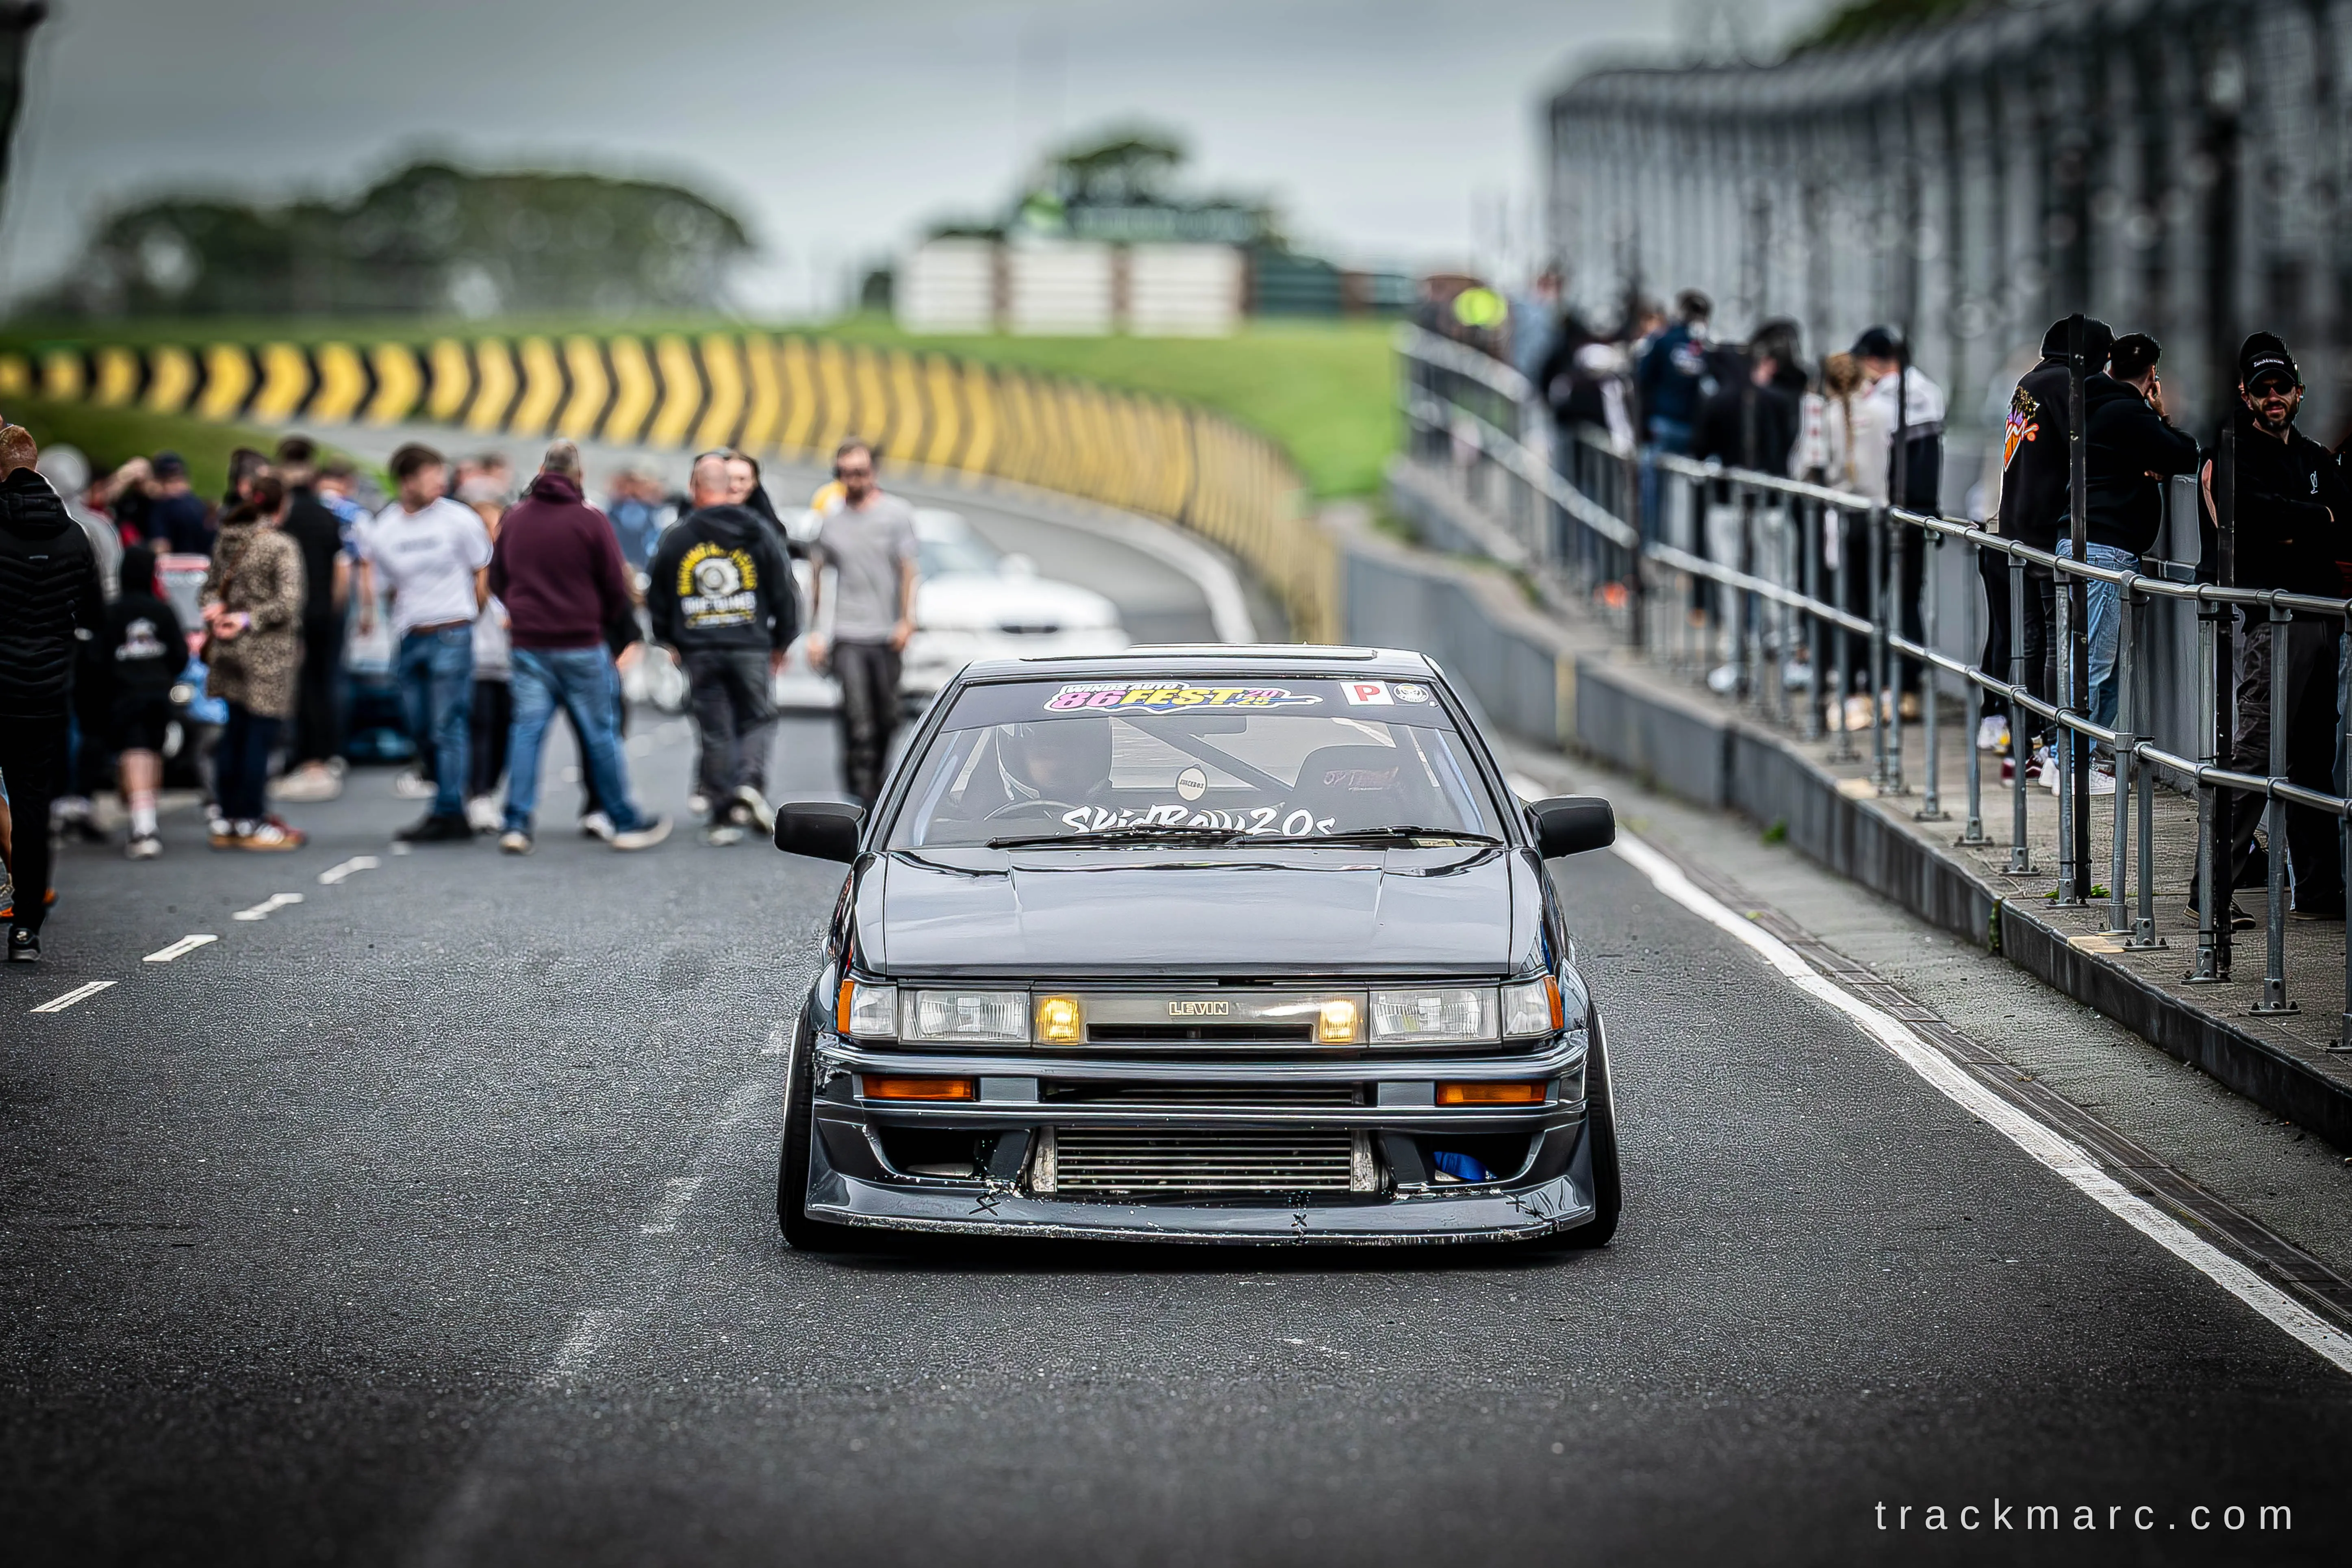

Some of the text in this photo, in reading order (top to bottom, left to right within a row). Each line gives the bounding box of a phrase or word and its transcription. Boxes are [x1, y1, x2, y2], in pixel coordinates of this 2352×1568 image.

[1354, 685, 1380, 701] P
[1237, 696, 1270, 705] 25
[1168, 1001, 1229, 1015] LEVIN
